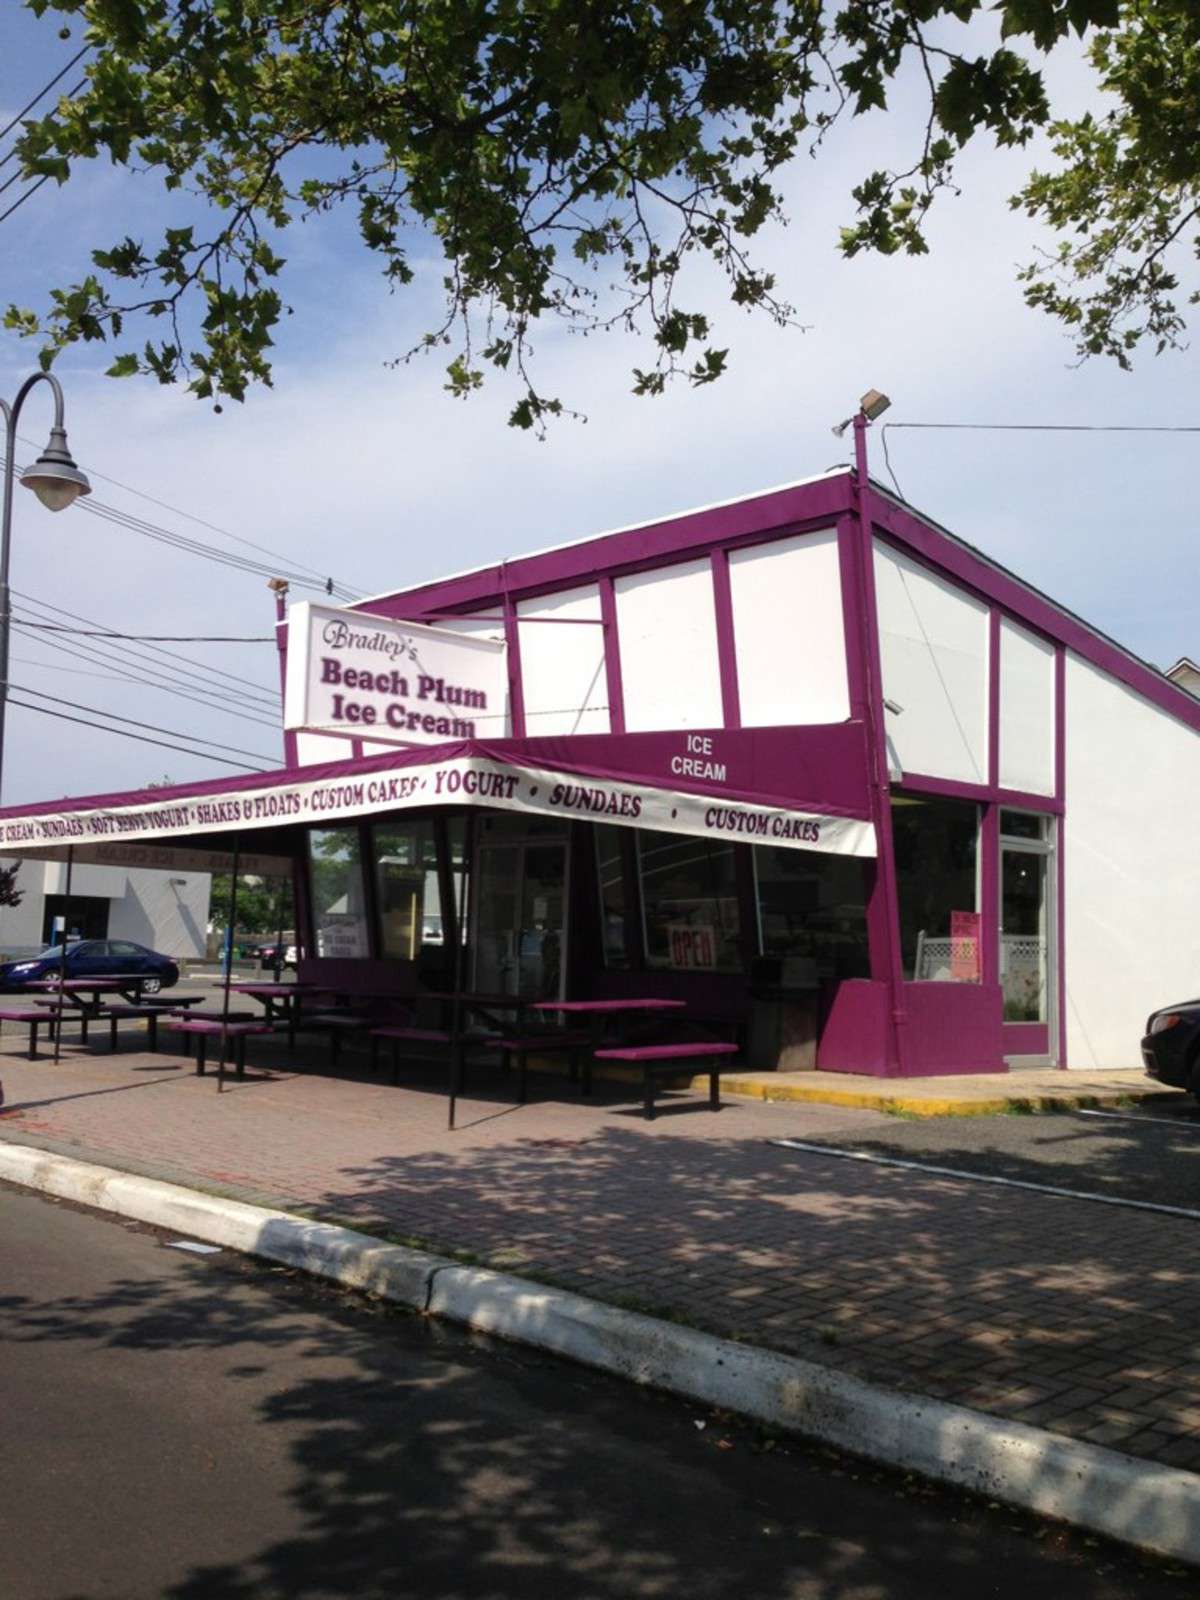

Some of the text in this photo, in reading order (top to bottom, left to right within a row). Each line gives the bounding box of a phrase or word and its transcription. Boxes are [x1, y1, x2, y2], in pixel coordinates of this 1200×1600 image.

[323, 619, 418, 661] Bradley's
[321, 657, 487, 709] Beach Plum
[332, 694, 476, 739] Ice Cream
[687, 734, 713, 756] ICE
[671, 755, 727, 782] CREAM
[90, 814, 115, 834] SOFT
[145, 807, 189, 829] YOGURT
[197, 801, 240, 824] SHAKES
[243, 799, 252, 820] &
[254, 793, 301, 818] FLOATS
[311, 782, 364, 811] CUSTOM
[368, 776, 419, 803] CAKES
[435, 769, 519, 798] YOGURT
[550, 784, 642, 818] SUNDAES
[705, 807, 769, 836] CUSTOM
[772, 817, 820, 842] CAKES
[672, 928, 713, 968] OPEN
